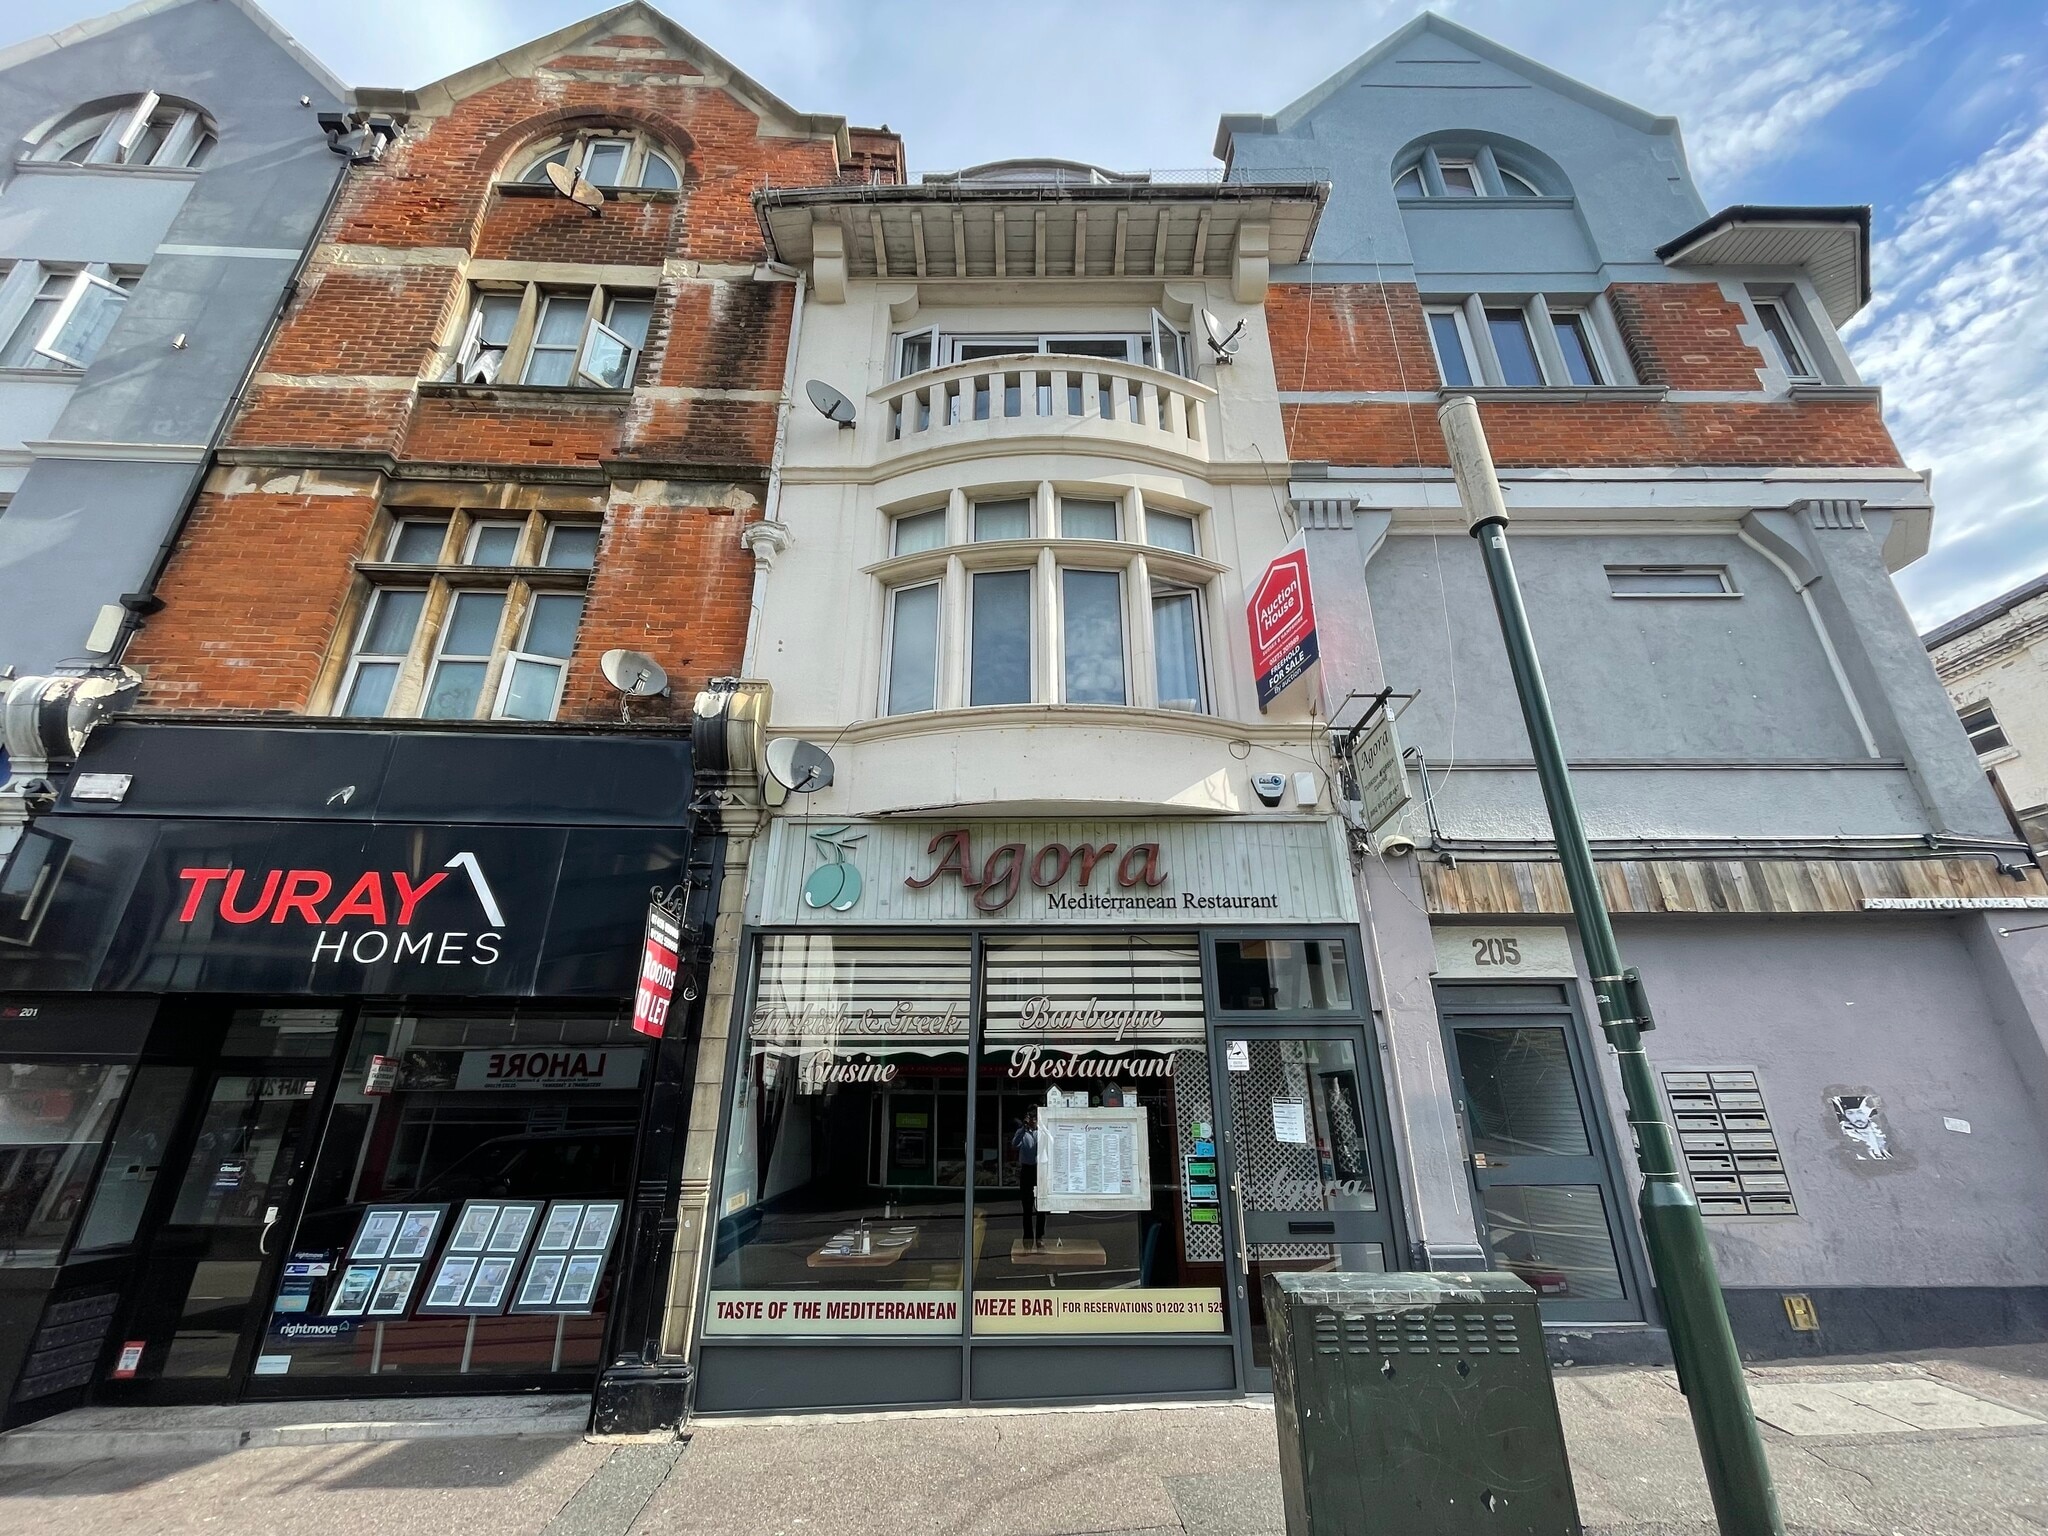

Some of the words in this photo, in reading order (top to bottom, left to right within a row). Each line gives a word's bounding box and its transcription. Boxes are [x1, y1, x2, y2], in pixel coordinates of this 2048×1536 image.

[1260, 580, 1297, 622] Auction
[1264, 596, 1295, 630] House
[1269, 672, 1285, 689] FOR
[1285, 651, 1305, 672] SALE
[1270, 645, 1301, 676] FREEHOLD
[1281, 667, 1302, 688] auction
[1361, 730, 1388, 771] Agora
[904, 828, 1168, 912] Agora
[179, 868, 450, 925] TURAY
[1048, 893, 1177, 909] Mediterranean
[1183, 893, 1278, 909] Restaurant
[1864, 898, 1905, 909] ASIAN
[1905, 898, 1932, 909] HOT
[1932, 898, 1960, 909] POT
[1960, 898, 1974, 908] &
[1973, 897, 2027, 908] KOREAN
[311, 930, 502, 965] HOMES
[1472, 938, 1521, 966] 205
[643, 951, 676, 991] Rooms
[19, 1008, 38, 1017] 201
[636, 988, 650, 1019] TO
[648, 994, 670, 1026] LET
[748, 1002, 854, 1035] Turkish
[855, 1008, 884, 1035] &
[884, 1001, 963, 1035] Greek
[1019, 995, 1165, 1042] Barbeque
[805, 1048, 899, 1083] Cuisine
[1008, 1043, 1180, 1079] Restaurant
[717, 1301, 763, 1320] TASTE
[768, 1301, 788, 1320] OF
[793, 1302, 821, 1320] THE
[826, 1302, 957, 1320] MEDITERRANEAN
[974, 1298, 1016, 1317] MEZE
[1021, 1298, 1053, 1317] BAR
[1062, 1302, 1081, 1314] FOR
[1084, 1302, 1153, 1314] RESERVATIONS
[1155, 1302, 1185, 1314] 01202
[1187, 1302, 1204, 1314] 311
[280, 1322, 338, 1337] rightmove
